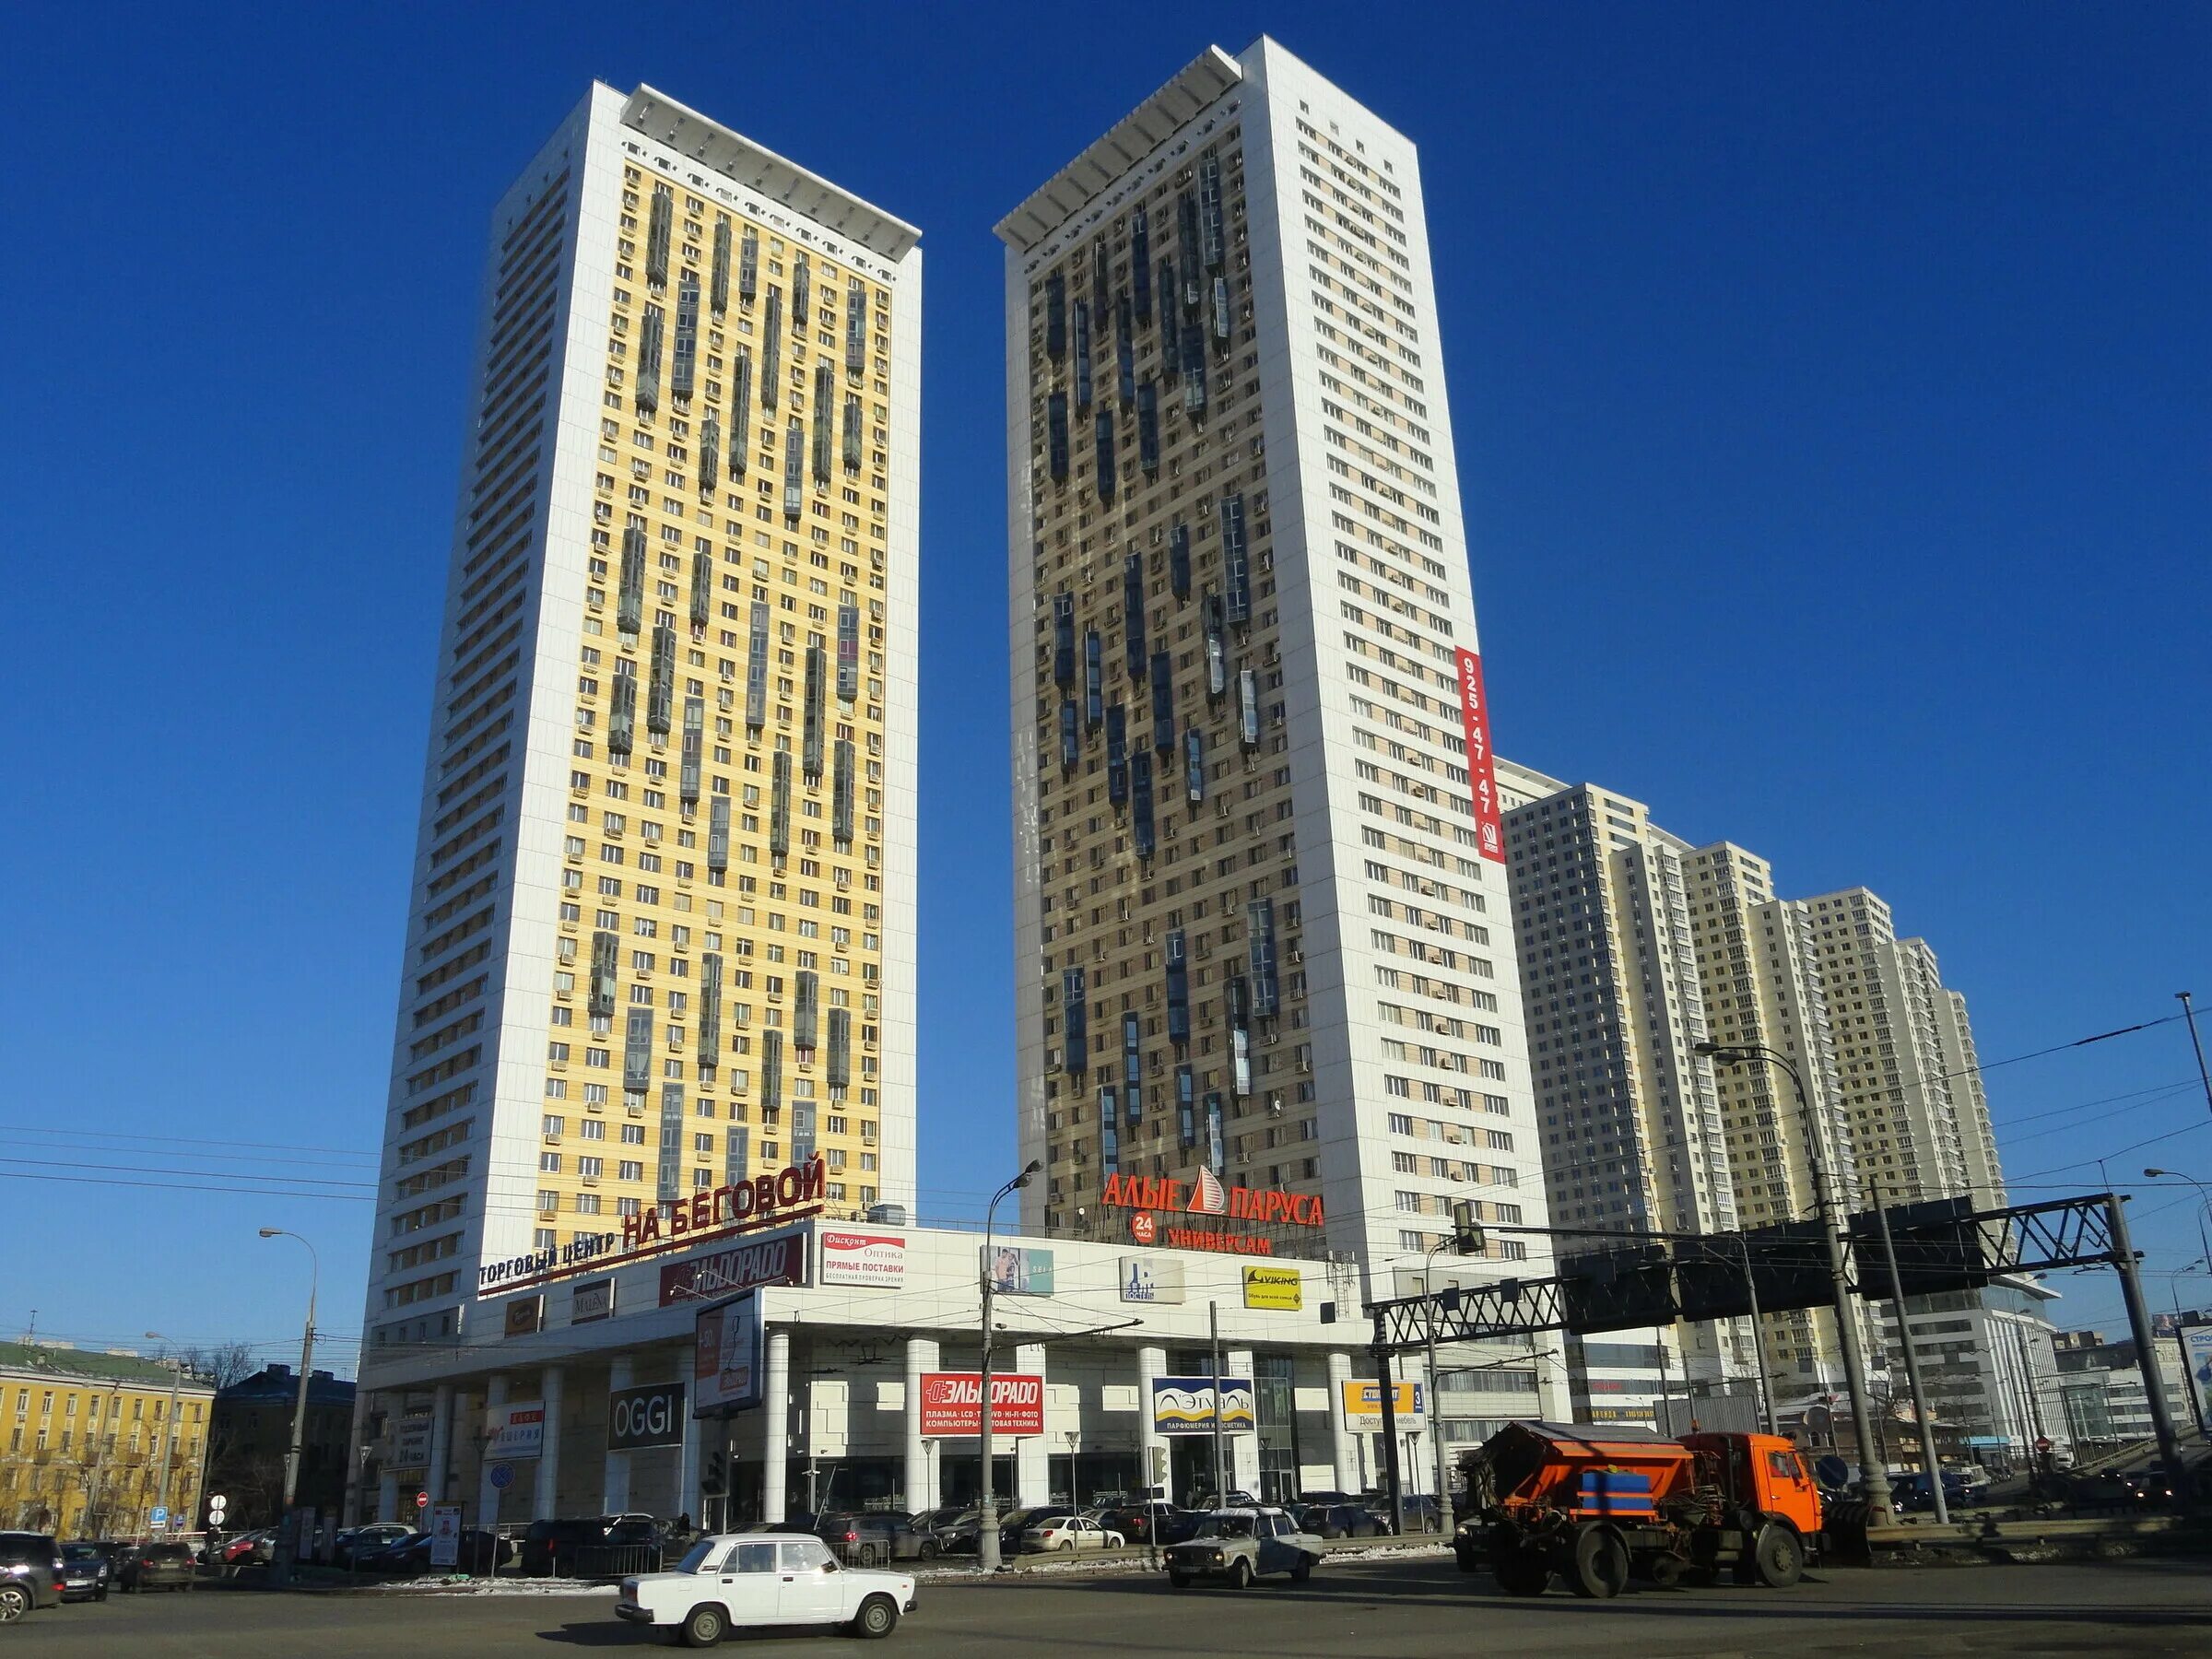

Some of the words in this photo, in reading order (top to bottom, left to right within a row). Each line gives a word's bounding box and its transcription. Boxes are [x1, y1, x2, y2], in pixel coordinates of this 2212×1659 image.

[1101, 1172, 1182, 1211] АЛЫЕ
[1230, 1186, 1324, 1228] ПАРУСА
[478, 1245, 558, 1285] ТОРГОВЫЙ
[563, 1232, 616, 1266] ЦЕНТР
[623, 1207, 662, 1249] НА
[670, 1150, 826, 1236] БЕГОВОЙ
[1135, 1216, 1153, 1230] 24
[827, 1234, 866, 1246] Дисконт
[1167, 1229, 1273, 1255] УНИВЕРСАМ
[864, 1248, 903, 1259] Оптика
[826, 1260, 860, 1271] ПРЯМЫЕ
[862, 1263, 904, 1274] ПОСТАВКИ
[1415, 1391, 1421, 1405] 3
[615, 1394, 673, 1437] OGGI
[925, 1410, 958, 1418] ПЛАЗМА
[960, 1410, 974, 1418] LCD
[1021, 1410, 1039, 1418] ФОТО
[925, 1419, 979, 1428] КОМПЬЮТЕРЫ
